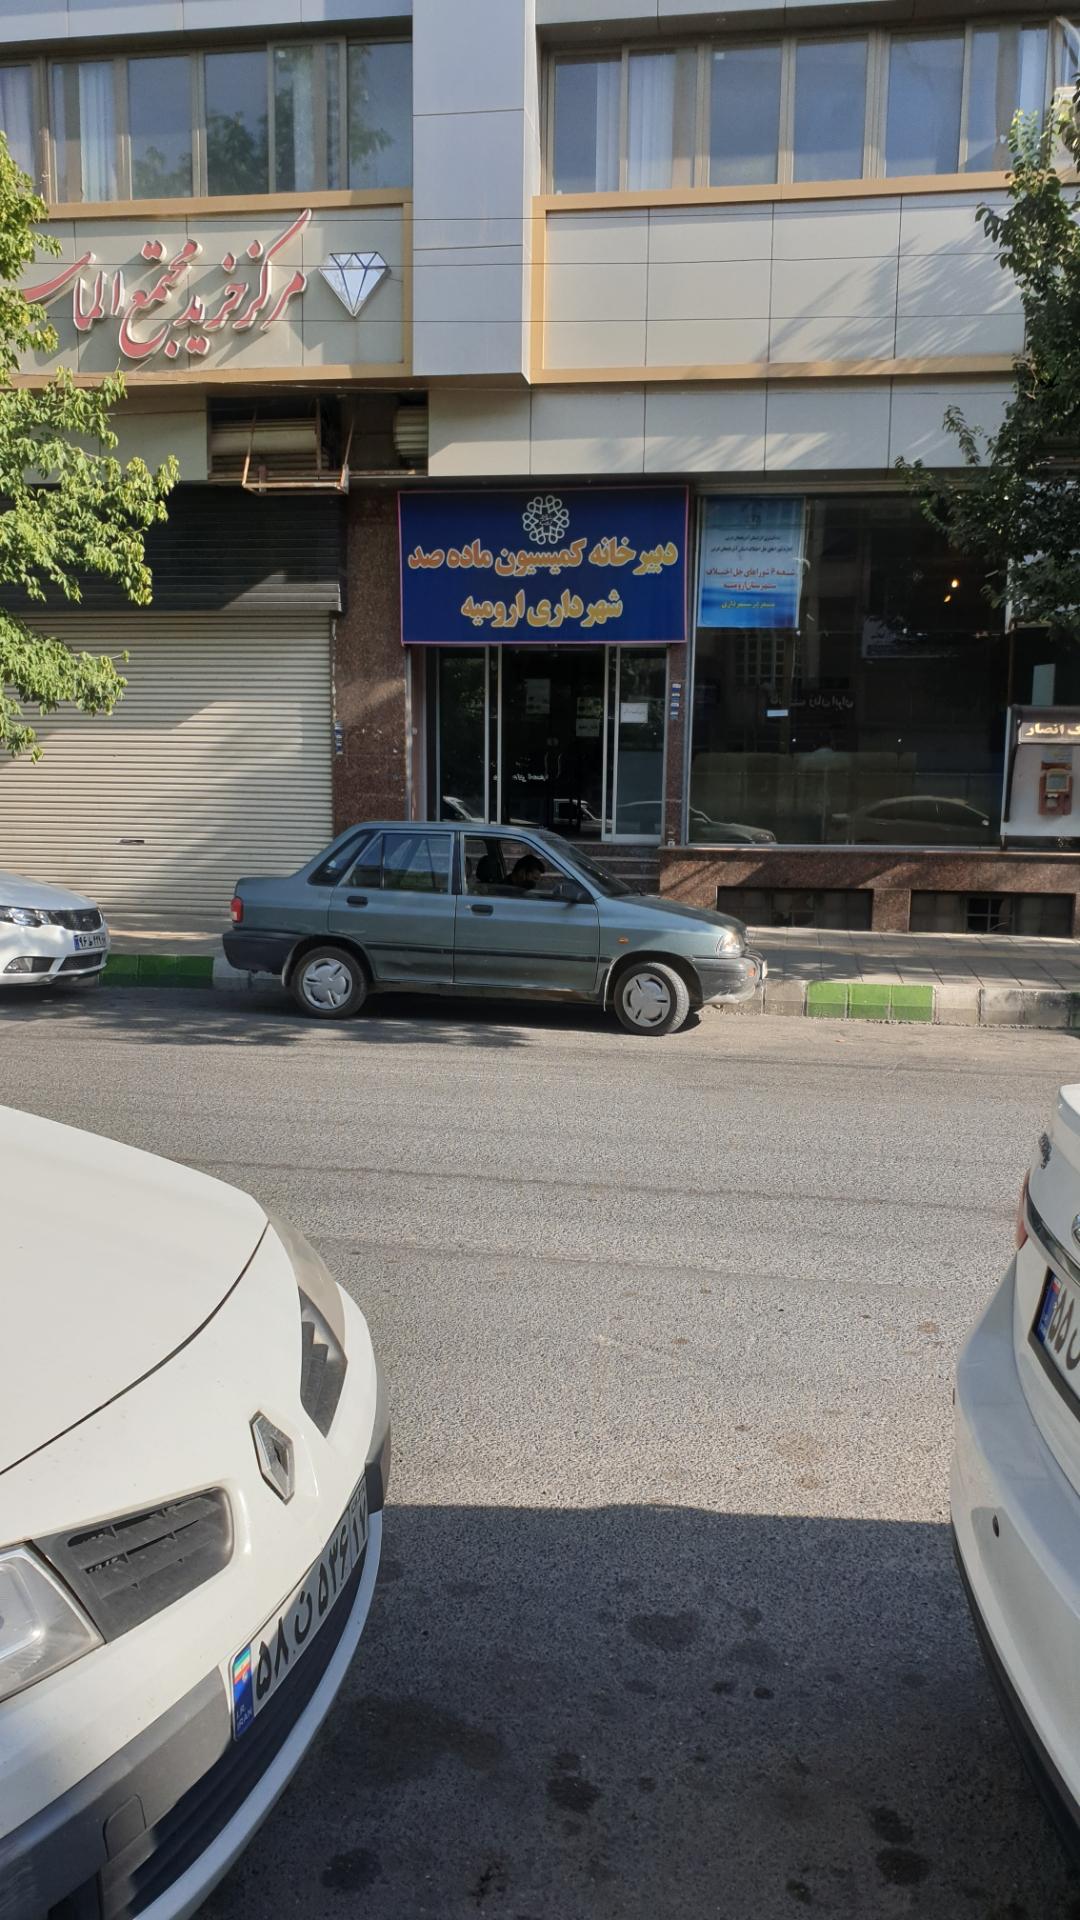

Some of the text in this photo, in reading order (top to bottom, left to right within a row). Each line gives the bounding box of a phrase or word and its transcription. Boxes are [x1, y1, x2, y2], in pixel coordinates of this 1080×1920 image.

[233, 208, 312, 332] مرکز
[118, 238, 203, 359] مجتمع
[173, 252, 249, 356] خرید
[407, 545, 445, 569] صد
[446, 538, 493, 569] ماده
[495, 537, 588, 577] کمیسیون
[460, 588, 624, 628] شهرداری ارومیه
[1024, 722, 1065, 737] انصار
